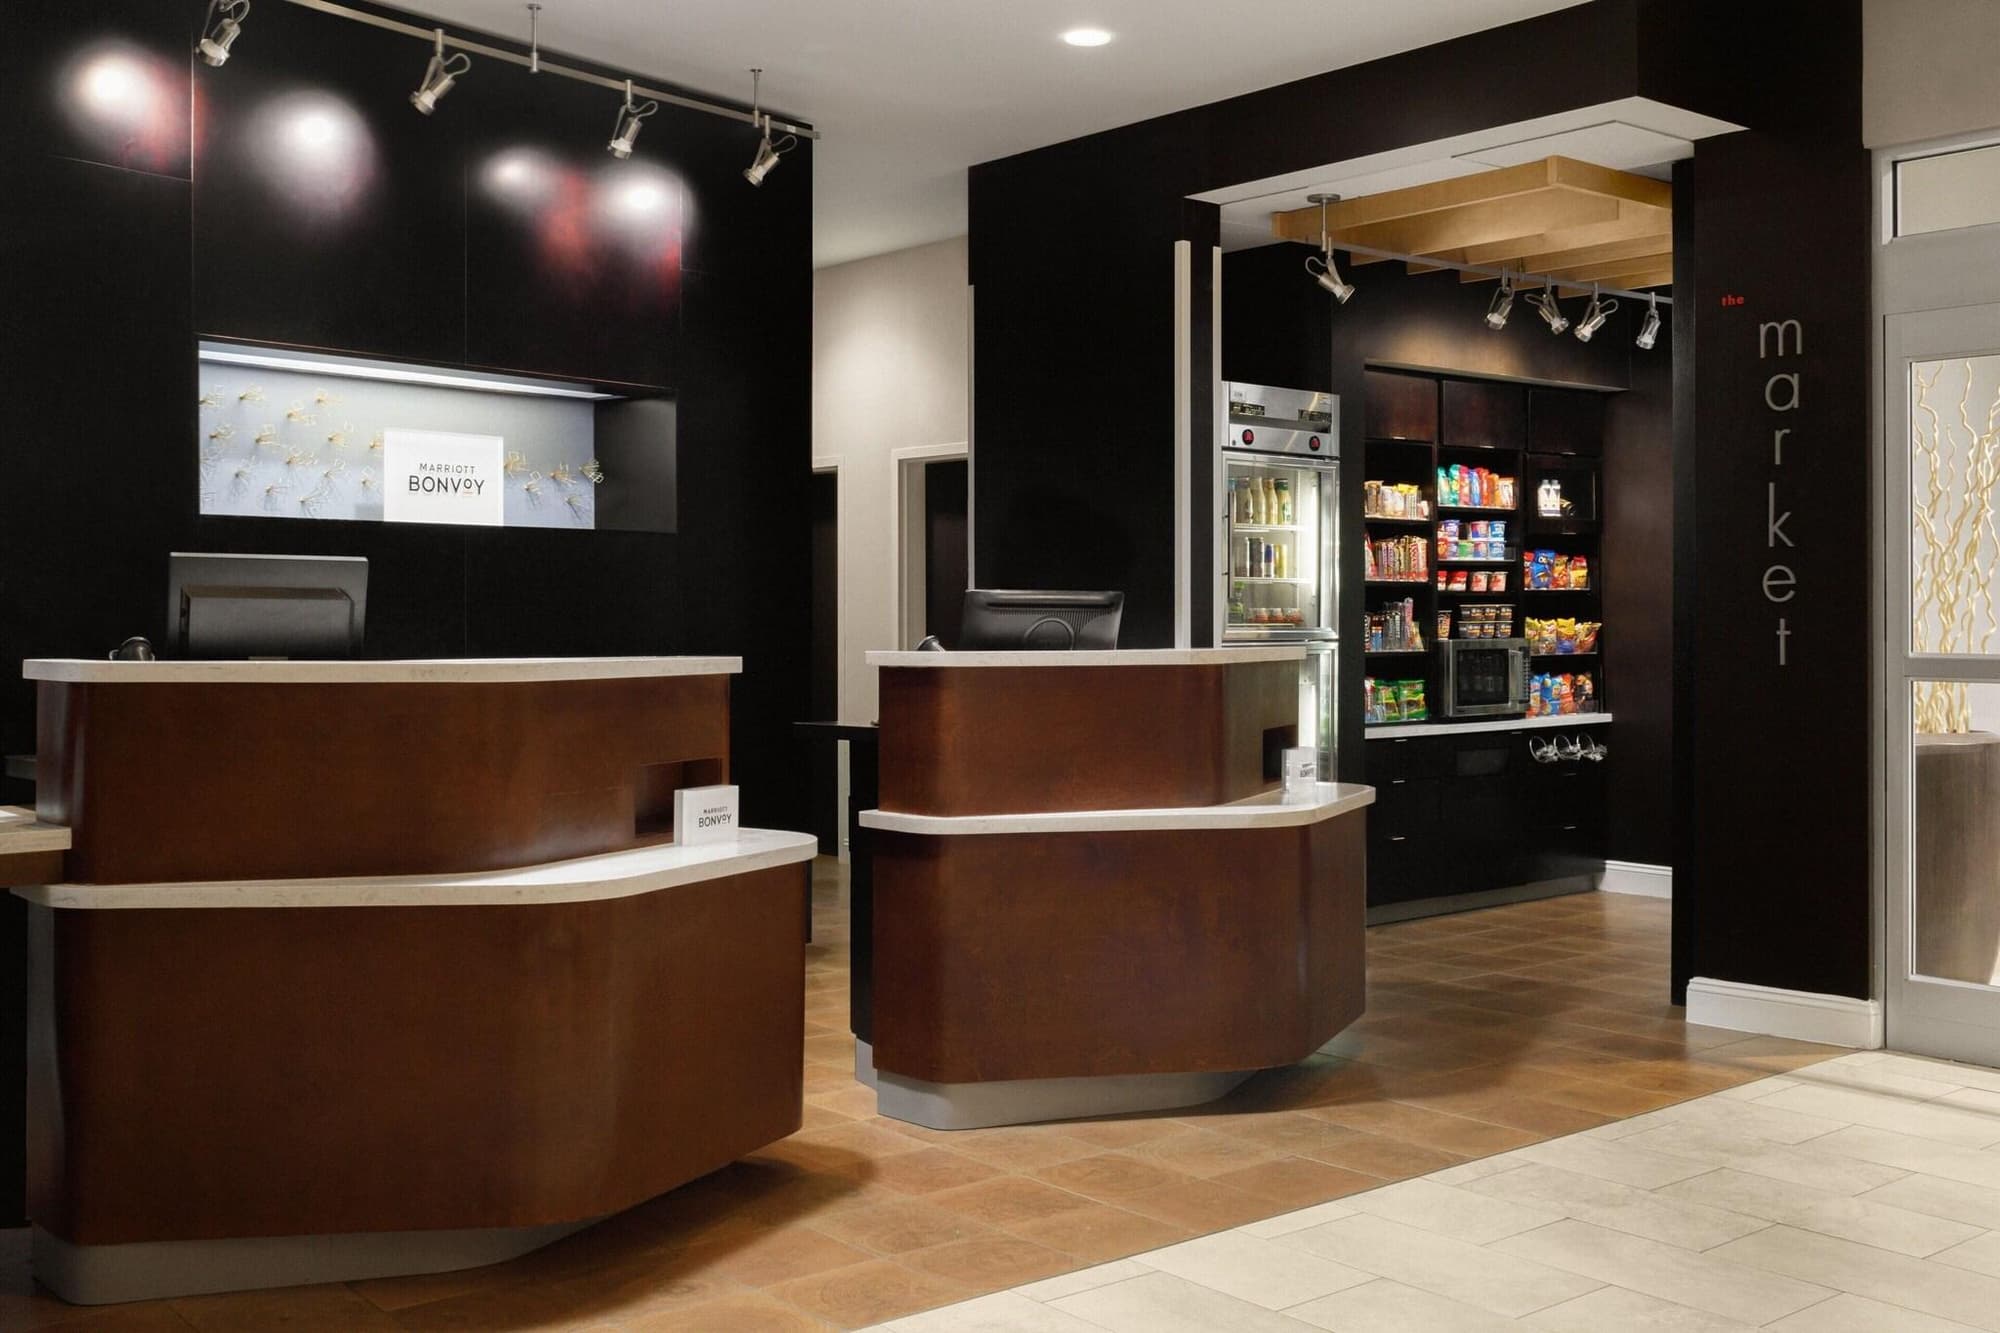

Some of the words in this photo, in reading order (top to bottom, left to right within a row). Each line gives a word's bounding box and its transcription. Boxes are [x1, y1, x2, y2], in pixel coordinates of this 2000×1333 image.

[1721, 294, 1744, 306] the
[419, 463, 475, 474] MARRIOTT
[408, 475, 485, 495] BONVOY
[1759, 318, 1803, 666] market
[698, 814, 732, 828] BONVOY
